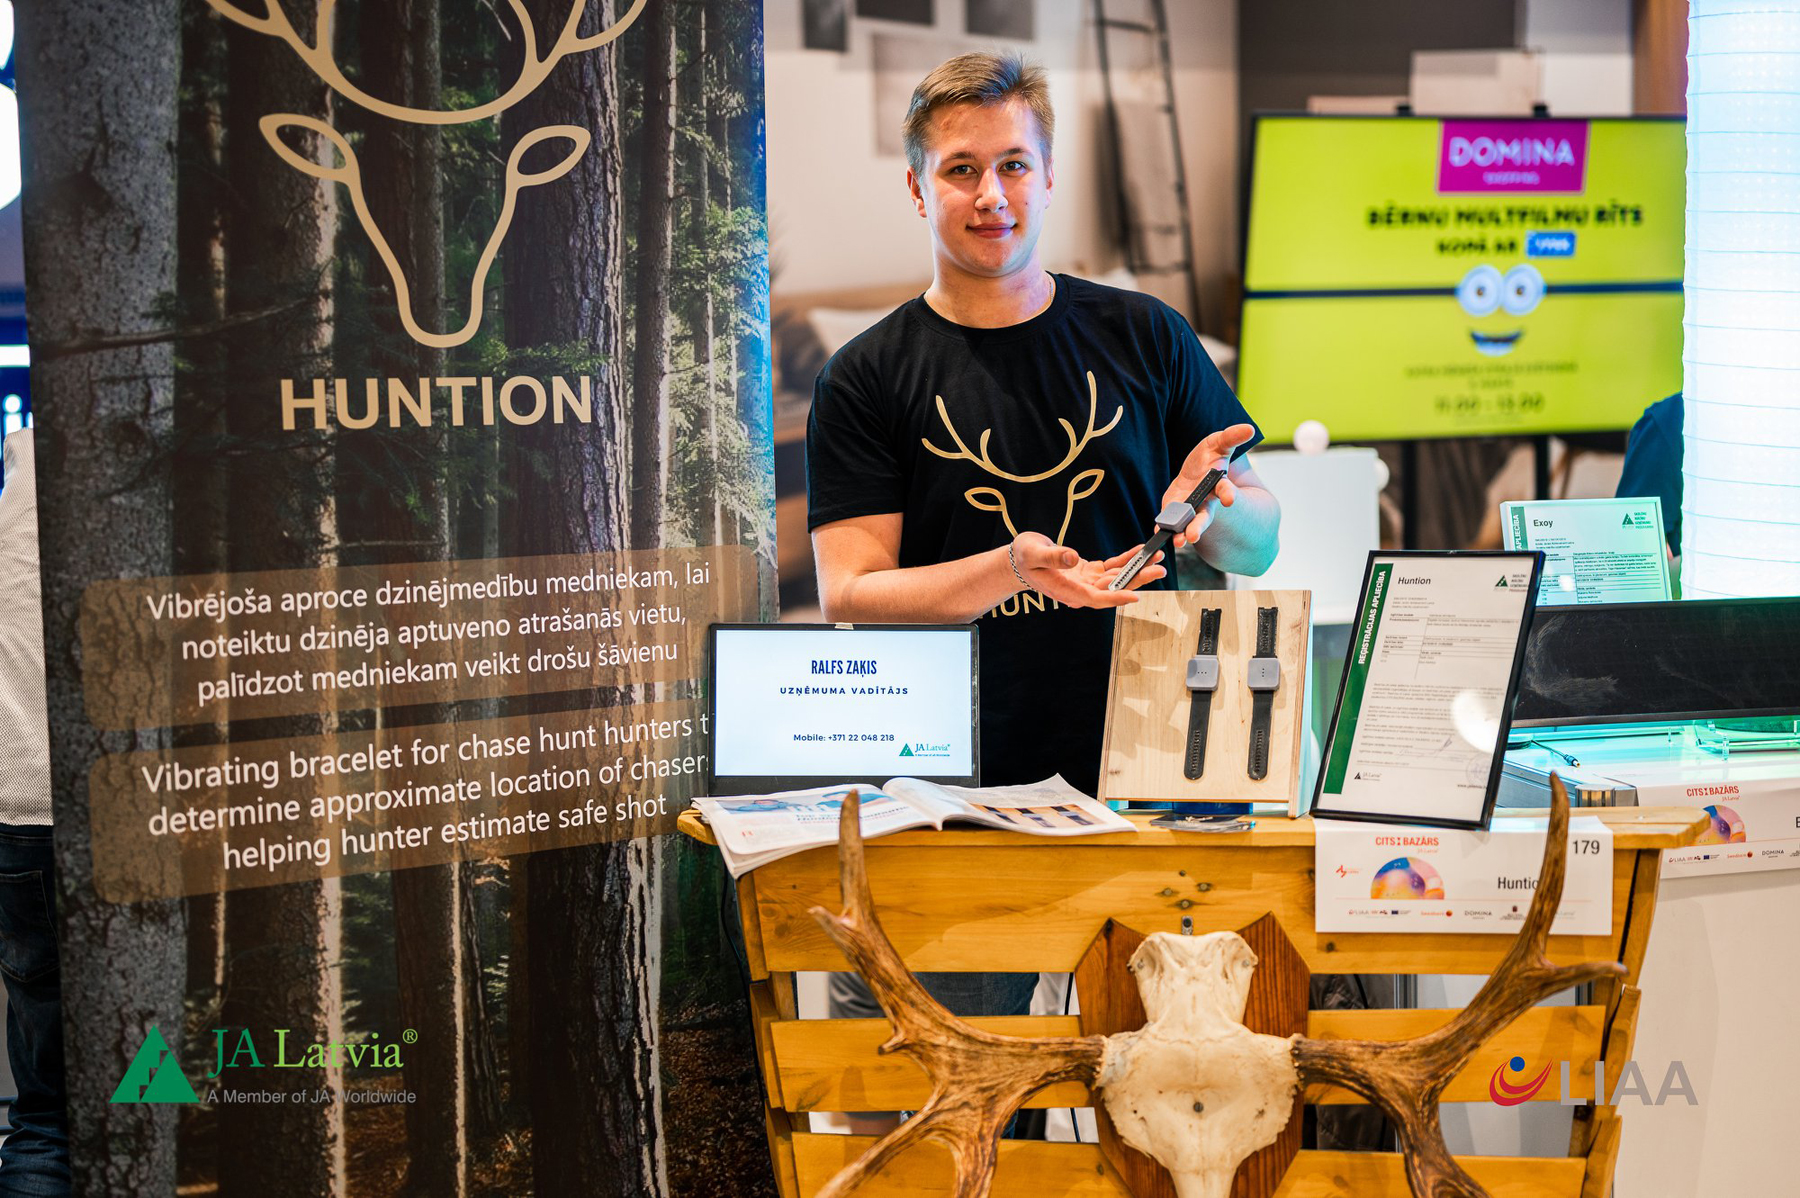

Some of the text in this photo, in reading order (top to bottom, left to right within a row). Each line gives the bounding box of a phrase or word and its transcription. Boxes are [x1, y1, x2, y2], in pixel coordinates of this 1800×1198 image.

[1449, 136, 1575, 167] DOMINA
[280, 375, 593, 431] HUNTION
[1533, 519, 1553, 529] Exoy
[1397, 577, 1432, 585] Huntion
[147, 562, 710, 624] Vibrējoša aproce dzinējmedību medniekam, lai
[182, 603, 687, 660] noteiktu dzinēja aptuveno atrašanās vietu,
[198, 641, 678, 707] palīdzot medniekam veikt drošu šāvienu
[811, 660, 877, 678] RALFS ZAĶIS
[780, 685, 909, 697] UZŅĒMUMA VADĪTĀJS
[793, 734, 895, 742] Mobile: +371 22 048 218
[141, 714, 708, 794] Vibrating bracelet for chase hunt hunters t
[914, 743, 925, 753] JA
[148, 796, 300, 836] determine
[310, 779, 481, 823] approximate
[490, 765, 590, 797] location
[599, 757, 624, 786] of
[1686, 785, 1739, 797] CITS BAZĀRS
[223, 794, 668, 872] helping hunter estimate safe shot
[1375, 835, 1439, 846] CITS BAZĀRS
[1572, 840, 1600, 856] 179
[1497, 877, 1539, 890] Huntio
